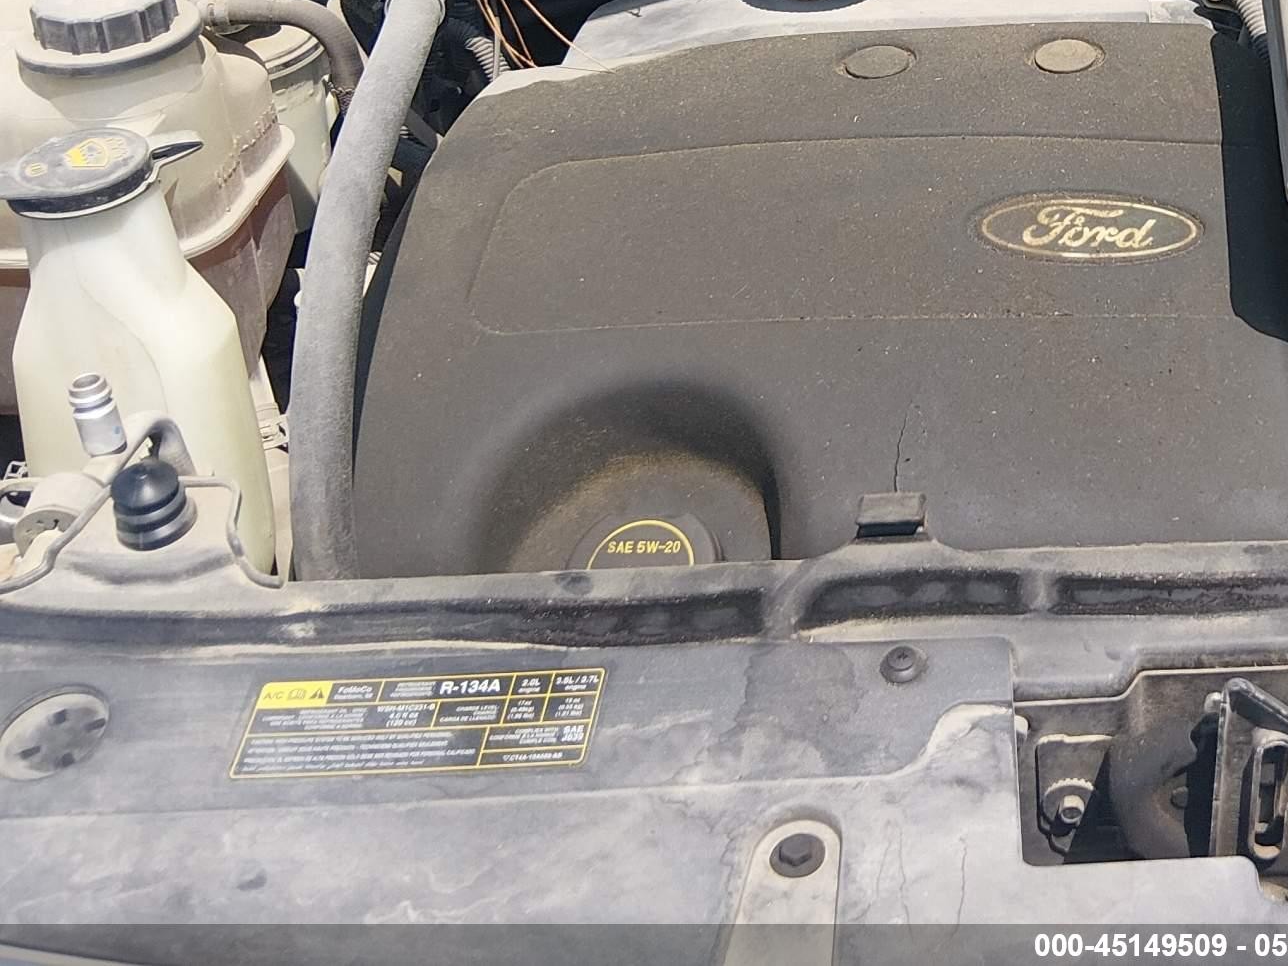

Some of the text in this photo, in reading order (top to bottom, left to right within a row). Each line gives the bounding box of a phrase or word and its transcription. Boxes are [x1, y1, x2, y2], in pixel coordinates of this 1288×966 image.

[1022, 205, 1156, 249] Ford
[607, 540, 681, 554] SAE 5W-20
[439, 679, 500, 695] R-134A
[263, 690, 283, 700] A/C
